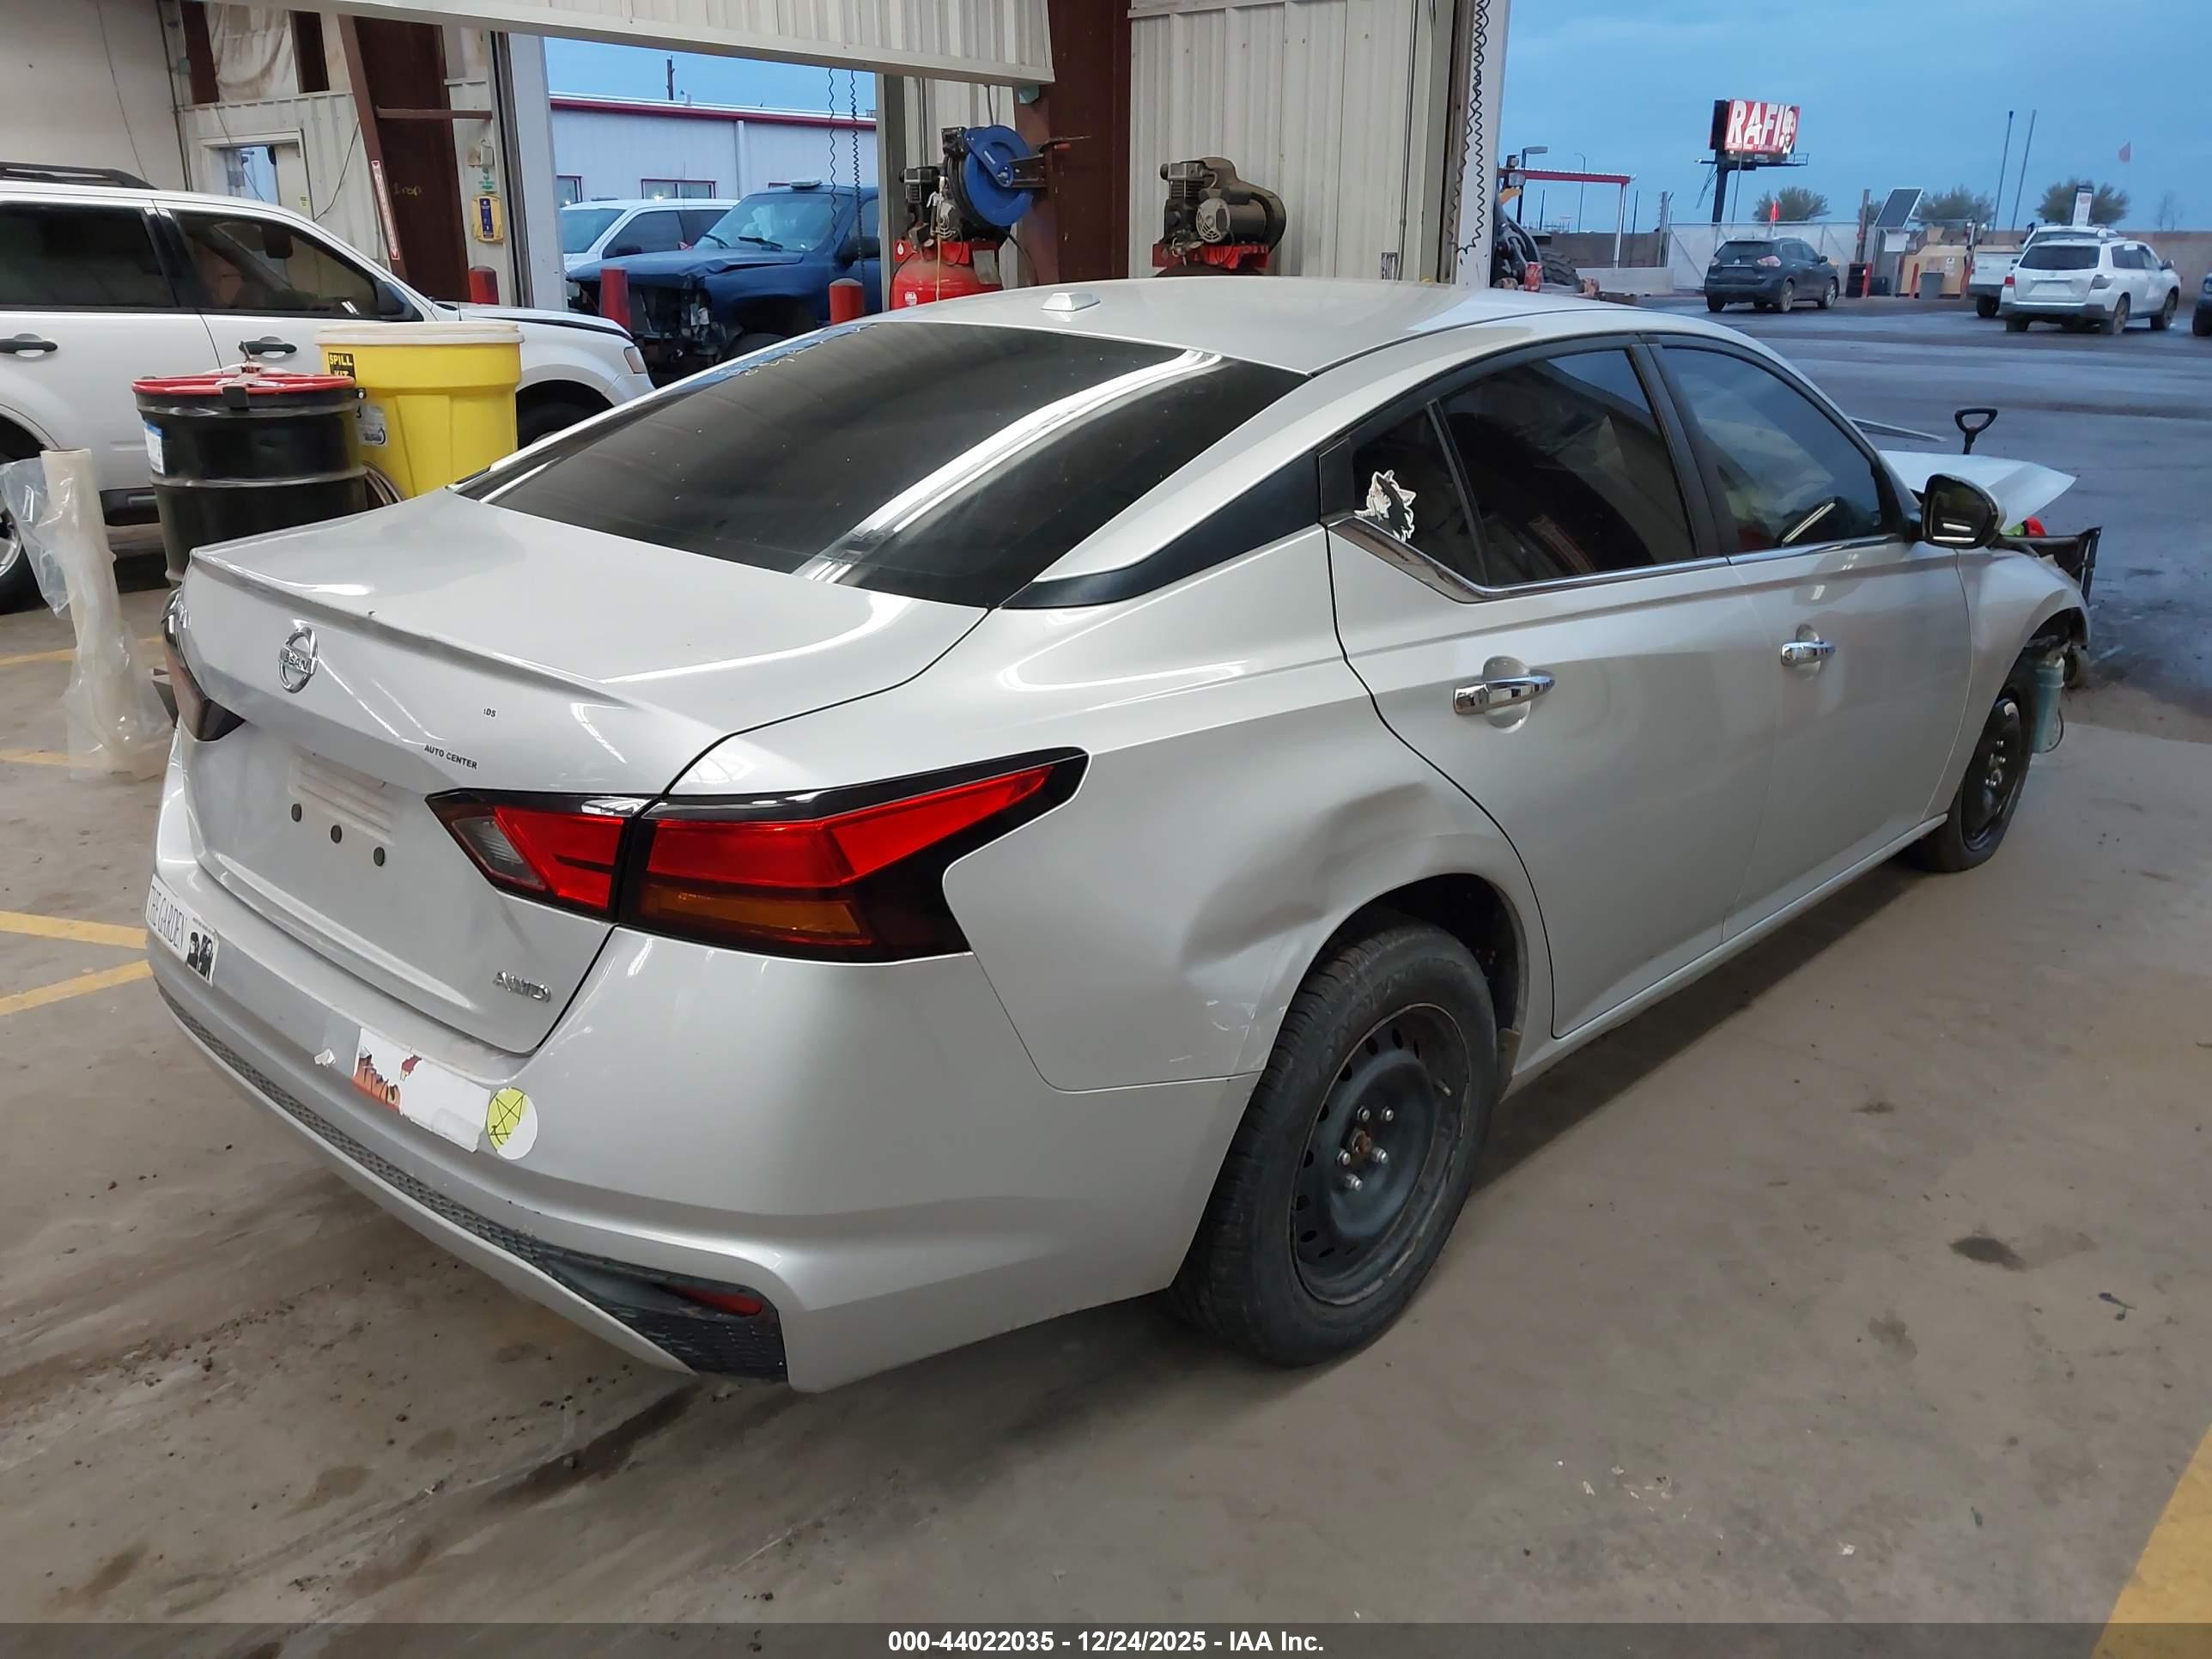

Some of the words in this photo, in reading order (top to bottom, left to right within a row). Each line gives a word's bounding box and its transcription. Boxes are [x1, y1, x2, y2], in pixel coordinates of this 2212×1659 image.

[328, 354, 354, 366] SPILL
[424, 744, 445, 757] AUTO
[446, 752, 478, 769] CENTER
[158, 897, 188, 951] GARDEN
[493, 971, 551, 1003] AWD
